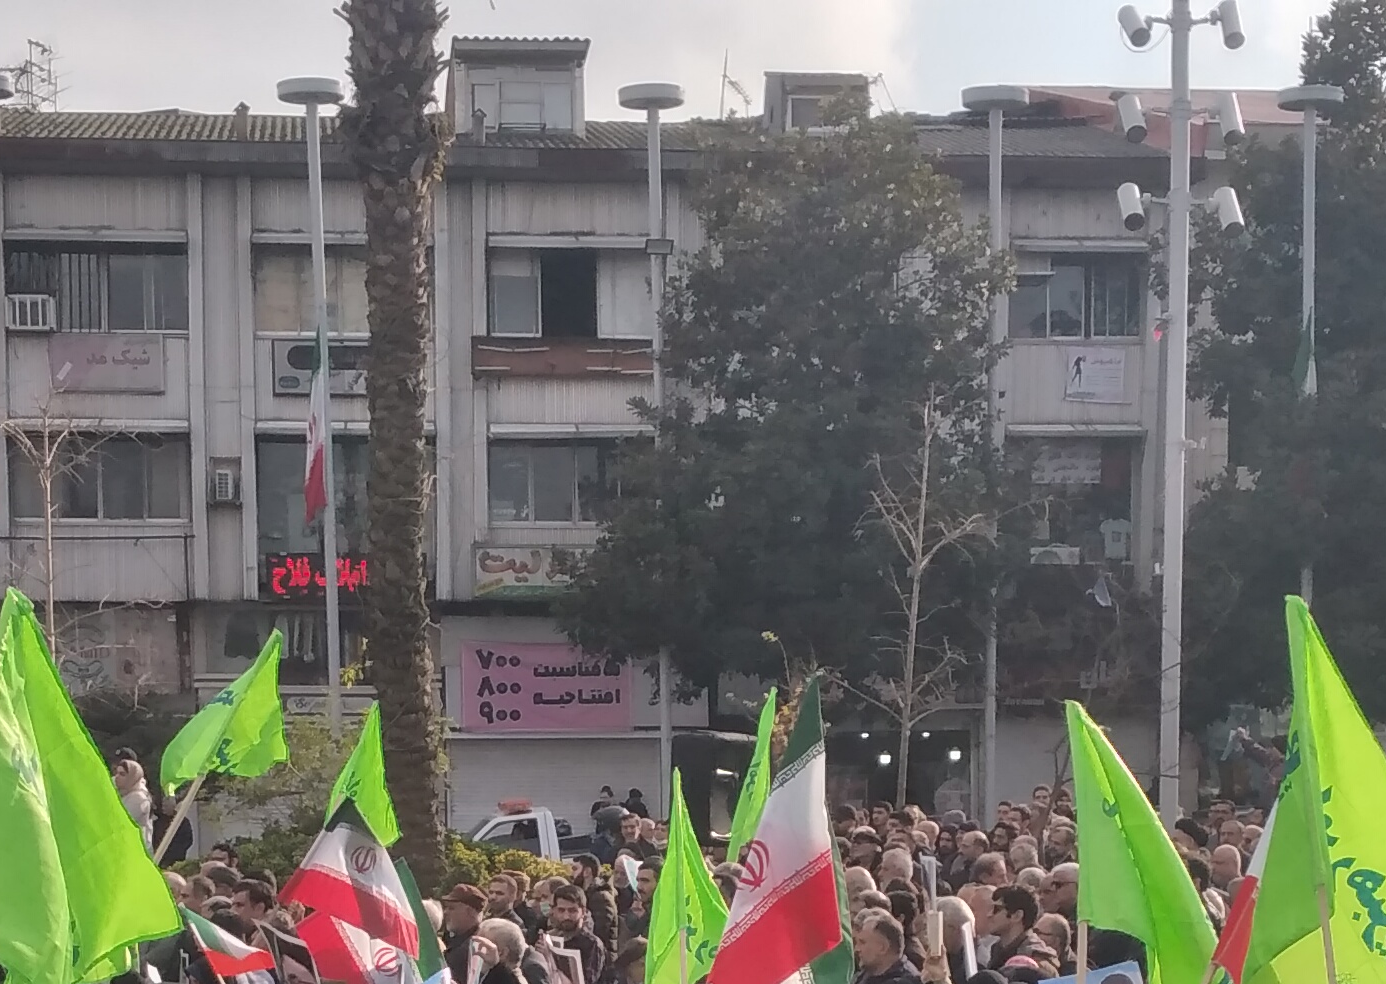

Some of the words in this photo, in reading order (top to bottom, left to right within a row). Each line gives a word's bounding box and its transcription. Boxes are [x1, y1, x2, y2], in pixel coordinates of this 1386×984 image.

[86, 351, 108, 365] مد
[112, 348, 150, 370] شیک
[475, 648, 521, 671] ۷۰۰
[532, 660, 603, 678] مناسبت
[477, 675, 522, 698] ۸۰۰
[532, 687, 621, 708] افتتاحیه
[478, 699, 522, 725] ۹۰۰
